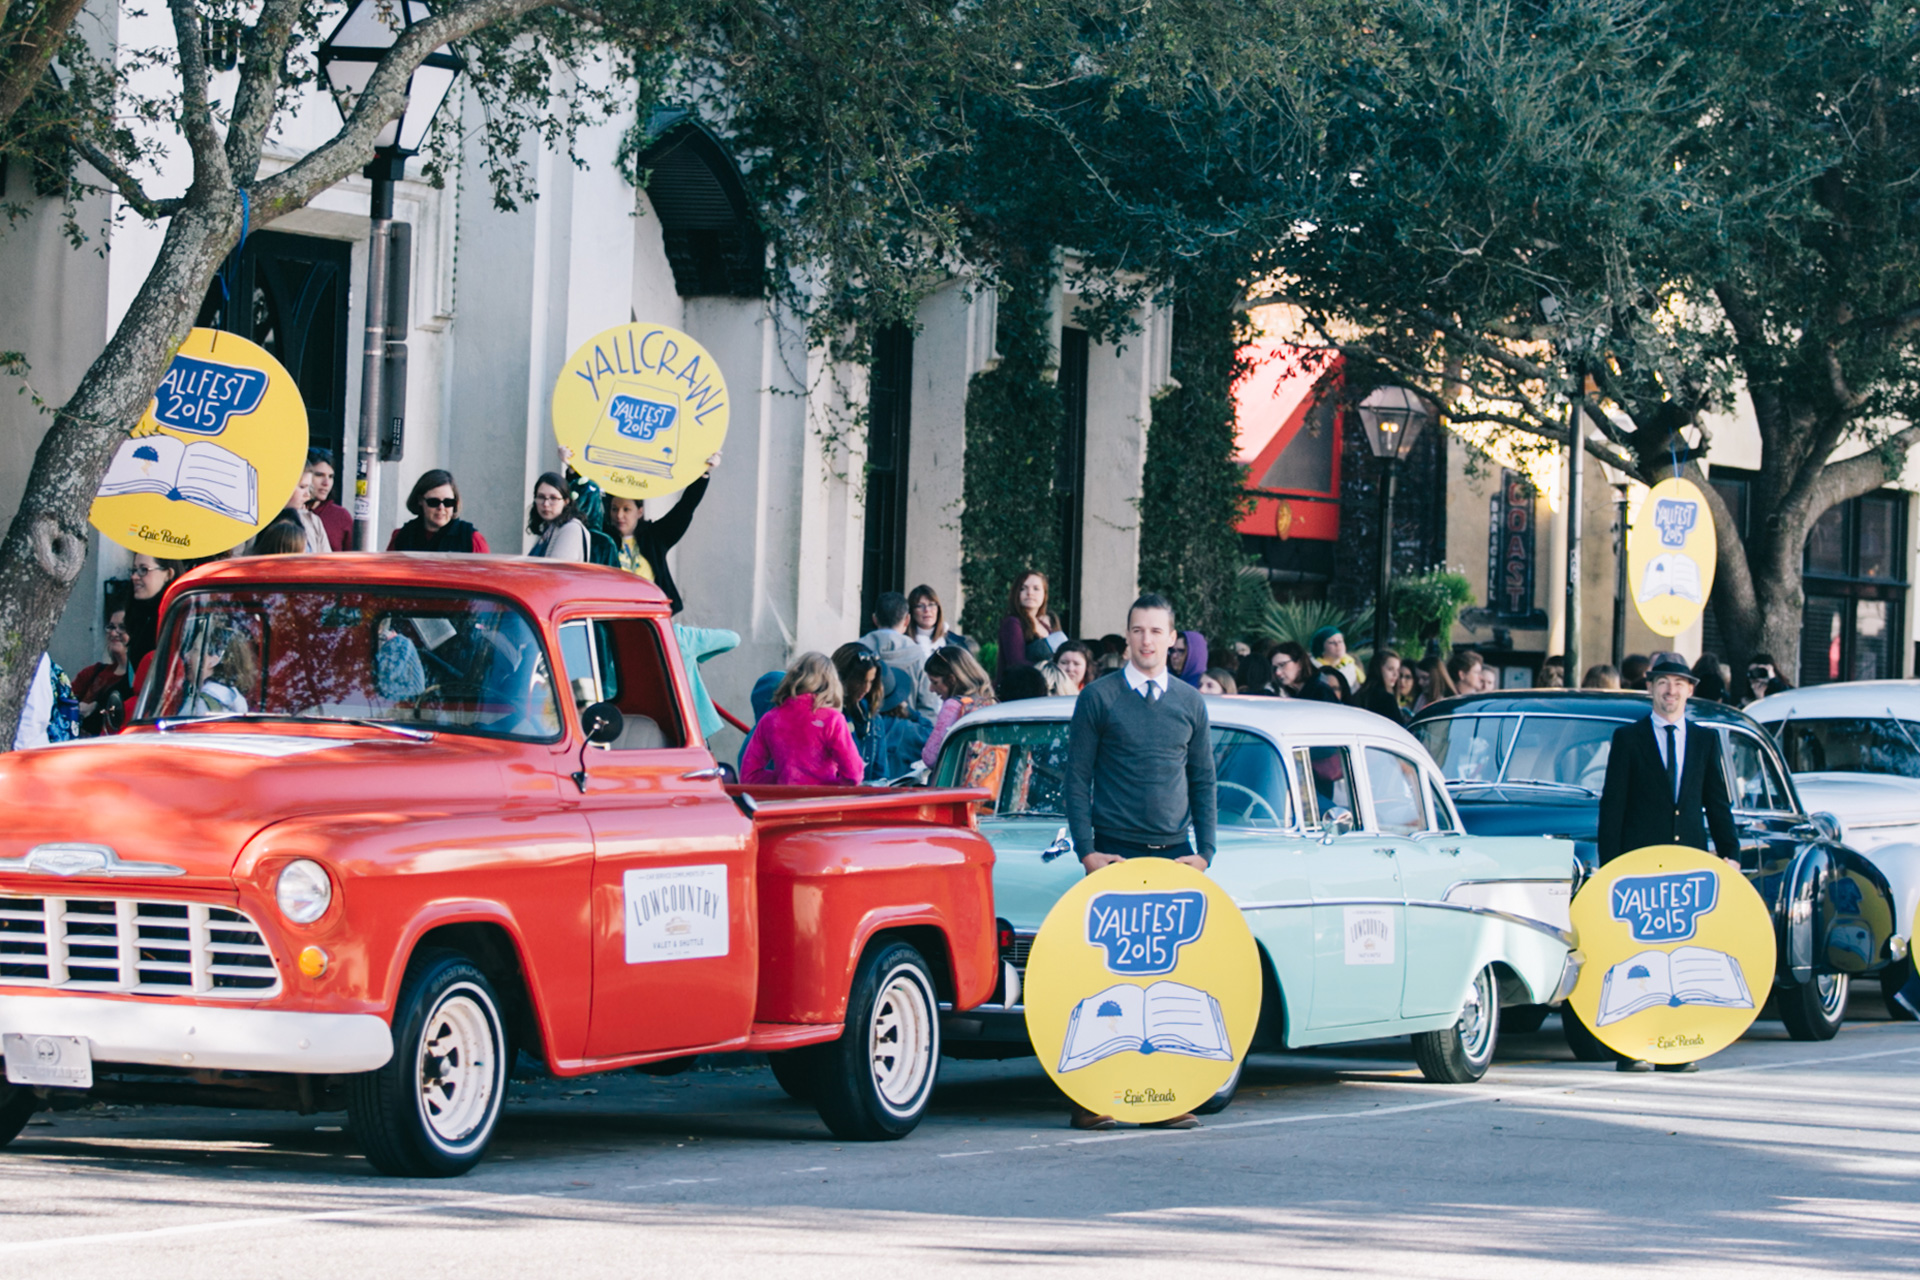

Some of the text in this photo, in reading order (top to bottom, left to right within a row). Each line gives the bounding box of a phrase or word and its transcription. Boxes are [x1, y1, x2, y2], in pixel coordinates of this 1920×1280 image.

[158, 369, 256, 406] ALLFEST
[575, 329, 725, 426] YALLCRAWL
[165, 396, 219, 426] 2015
[613, 399, 671, 427] YALLFEST
[622, 419, 652, 438] 2015
[1656, 504, 1695, 527] YALLFEST
[138, 525, 160, 541] Epic
[160, 528, 191, 547] Reads
[1505, 482, 1529, 612] COAST
[1664, 525, 1684, 544] 2015
[633, 884, 720, 926] LOWCOUNTRY
[1614, 877, 1707, 916] YALLFEST
[1092, 898, 1194, 939] YALLFEST
[1639, 909, 1687, 936] 2015
[1116, 935, 1167, 965] 2015
[1657, 1034, 1705, 1050] Epic Reads
[1124, 1088, 1176, 1106] Epic Reads
